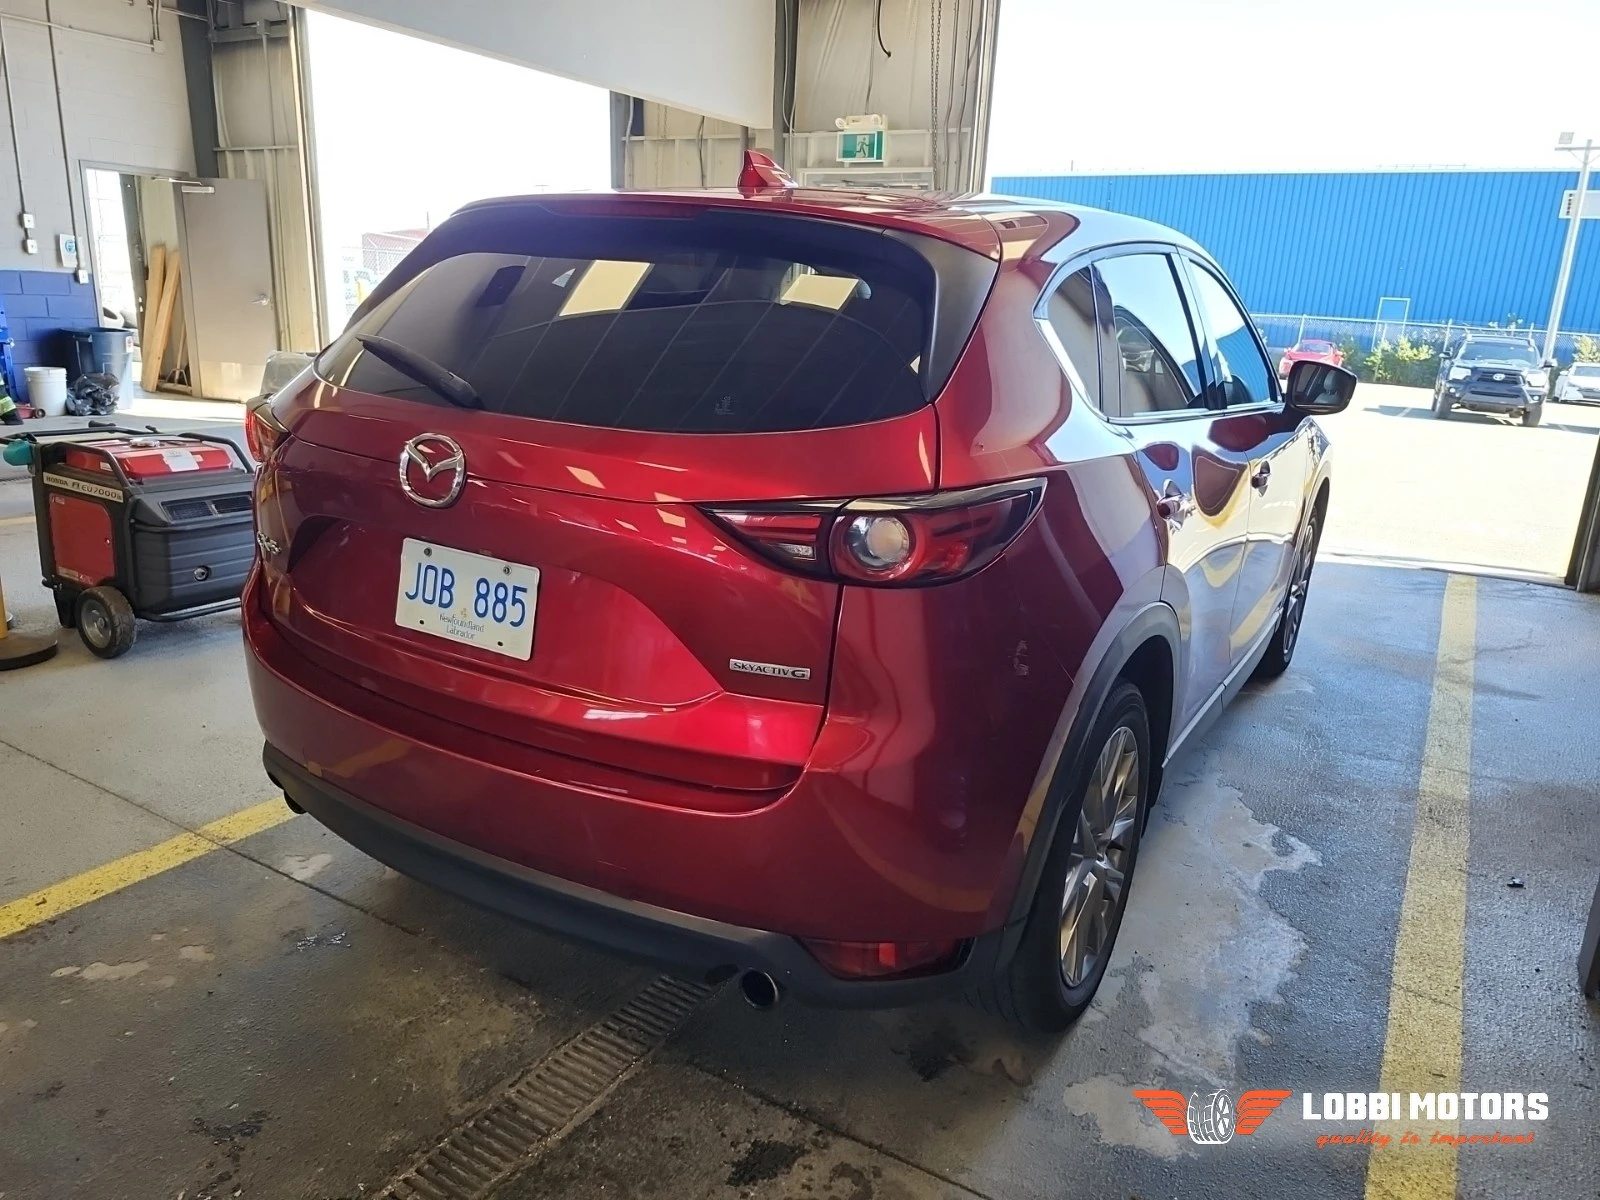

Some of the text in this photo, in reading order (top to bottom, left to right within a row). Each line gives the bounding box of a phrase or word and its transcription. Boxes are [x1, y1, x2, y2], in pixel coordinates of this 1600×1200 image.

[46, 476, 68, 487] HONDA
[404, 562, 528, 627] JOB 885
[439, 612, 485, 633] Newfoundland
[446, 625, 475, 640] Labrador
[733, 662, 790, 676] SKYACTIV
